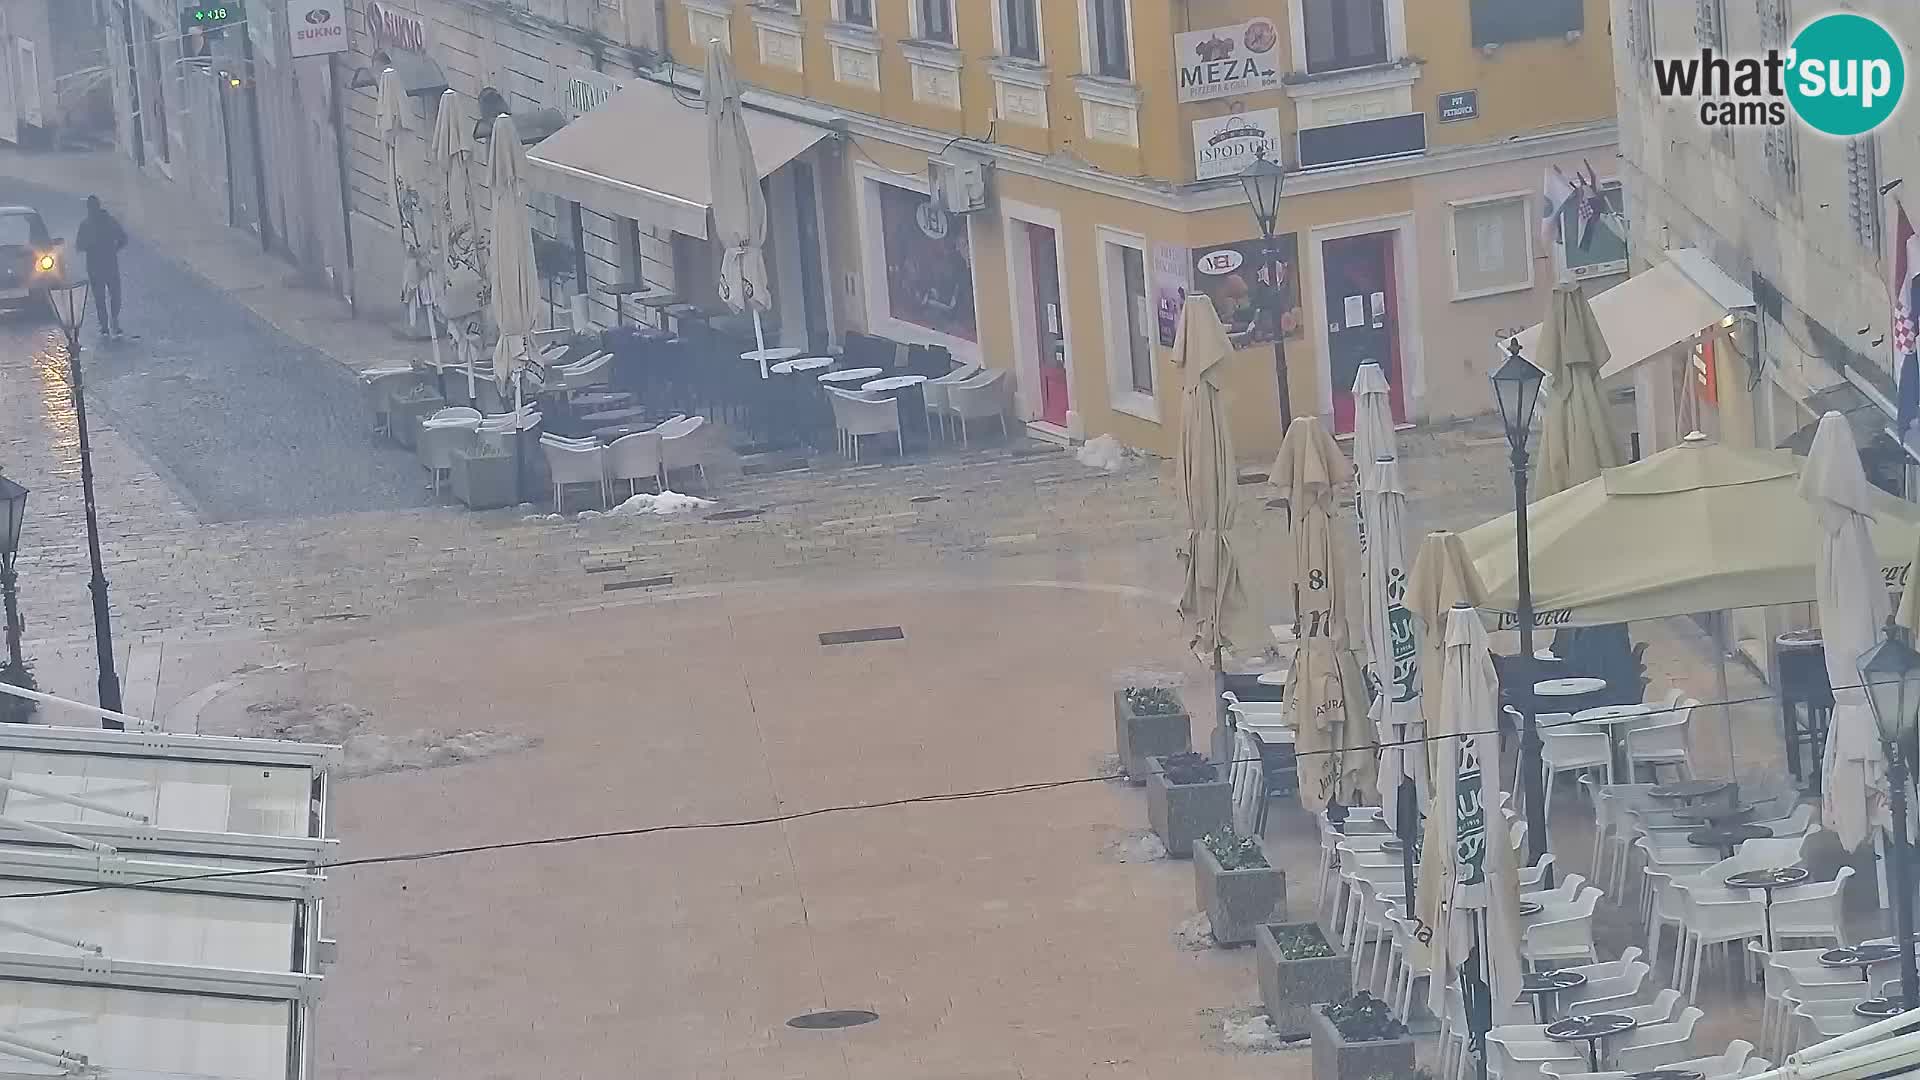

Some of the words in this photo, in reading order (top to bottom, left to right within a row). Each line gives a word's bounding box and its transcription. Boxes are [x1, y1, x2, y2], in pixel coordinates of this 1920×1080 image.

[297, 27, 342, 40] SUKNO
[383, 9, 423, 50] SUKNO
[1181, 57, 1259, 88] MEZA
[1199, 143, 1245, 161] ISPOD
